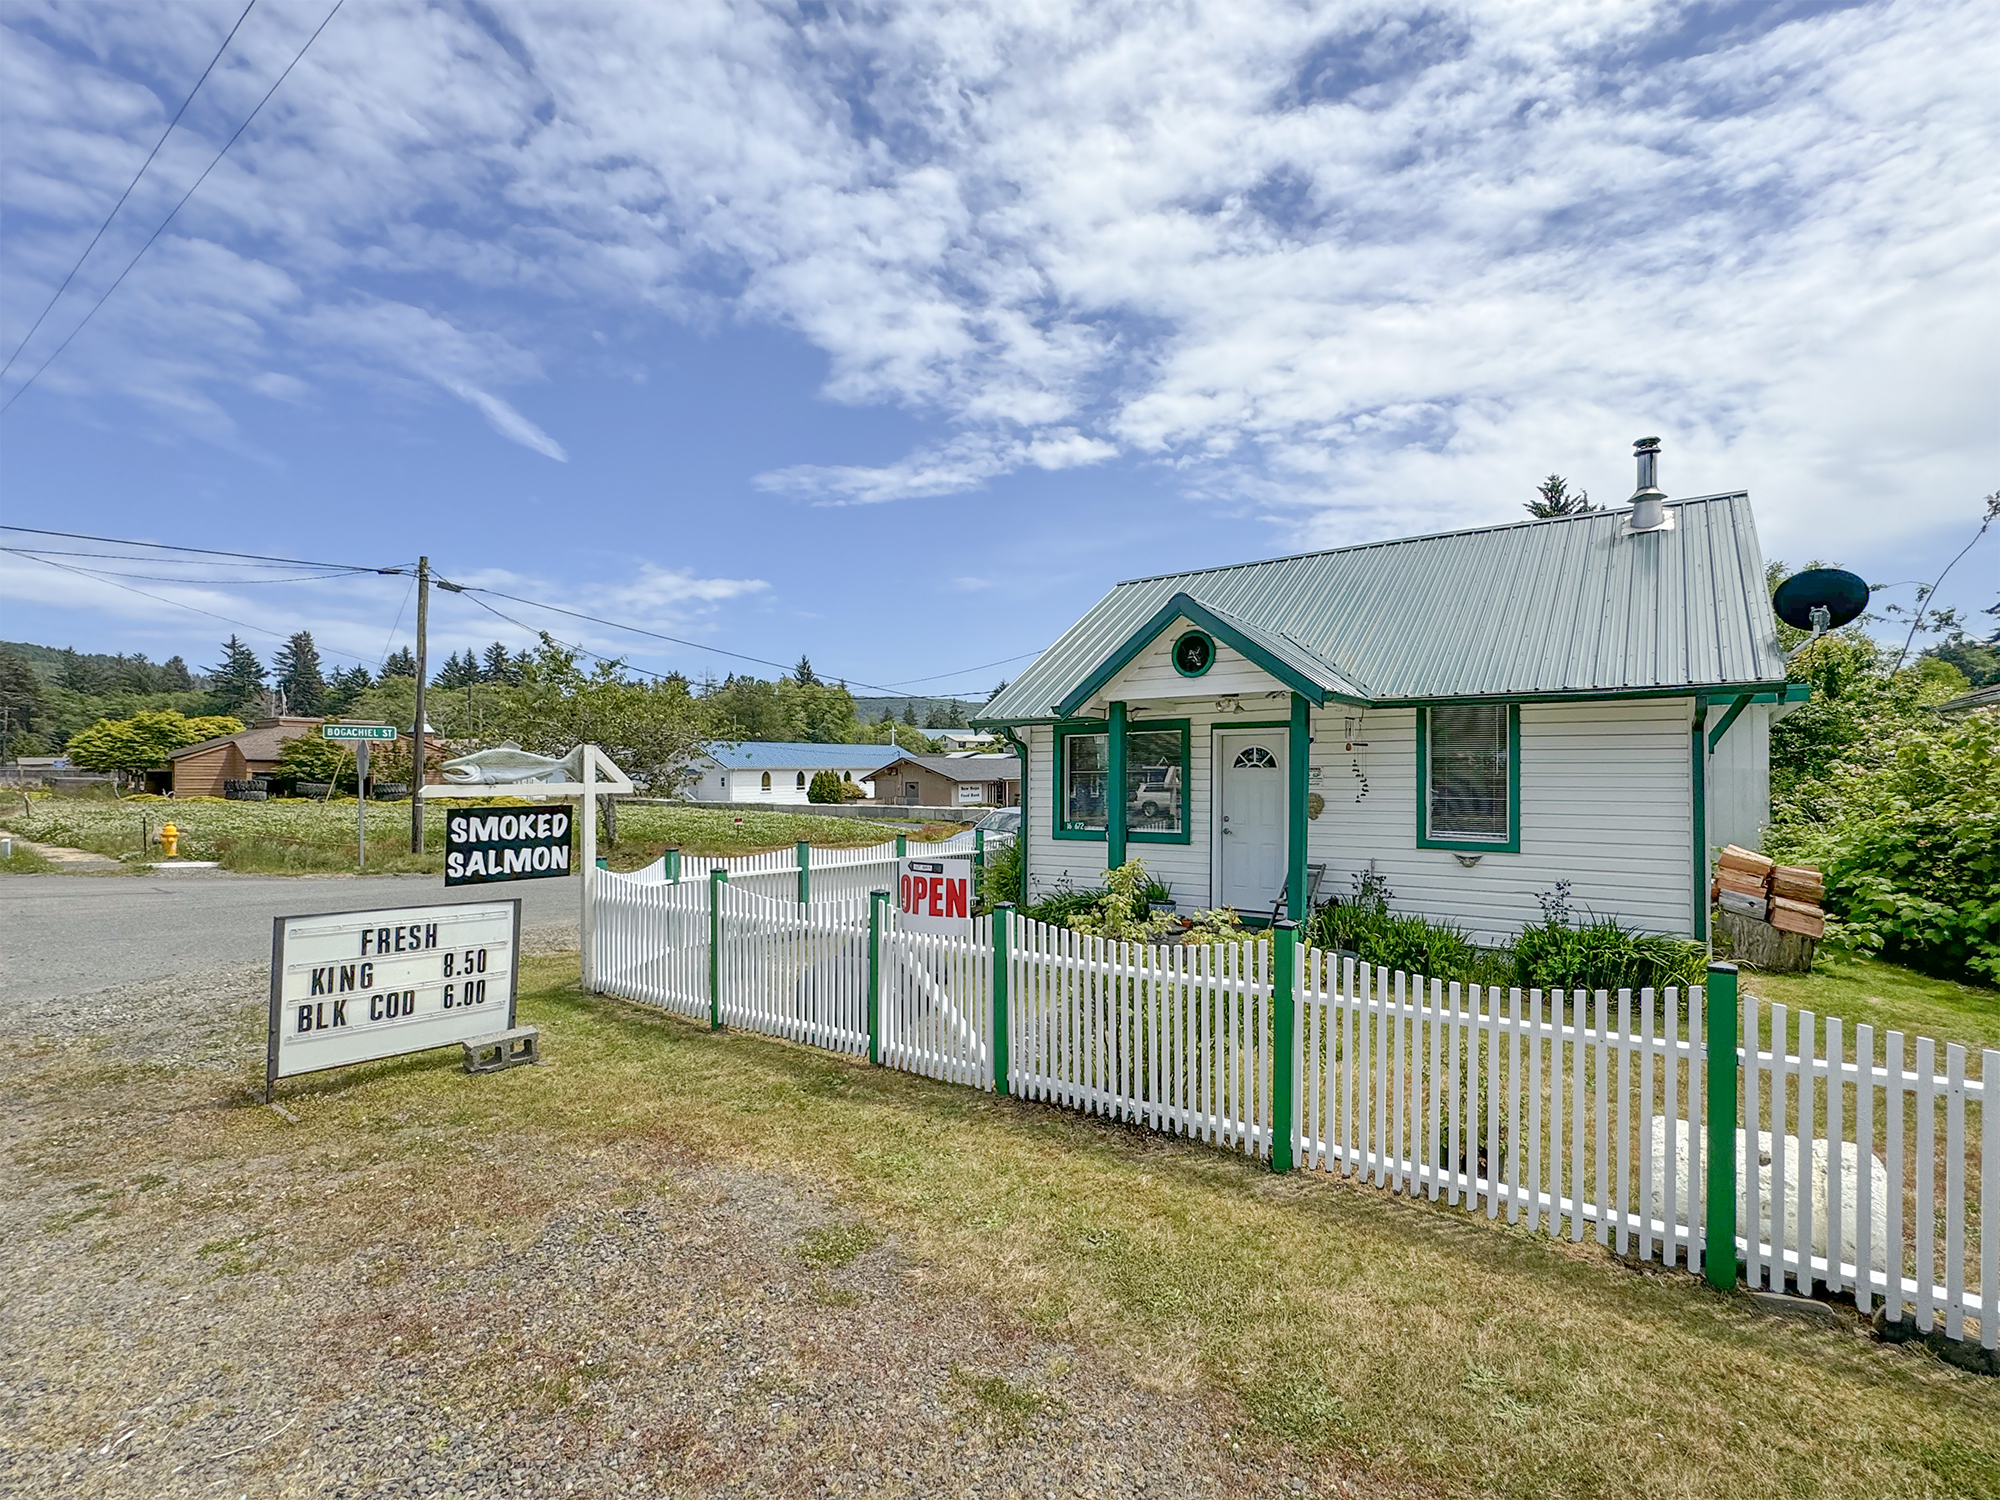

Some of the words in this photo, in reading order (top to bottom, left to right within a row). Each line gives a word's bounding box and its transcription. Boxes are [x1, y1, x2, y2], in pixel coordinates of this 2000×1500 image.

[327, 728, 379, 737] BOGACHIEL
[382, 729, 393, 738] ST
[450, 813, 569, 843] SMOKED
[447, 845, 569, 878] SALMON
[900, 874, 967, 918] OPEN
[361, 923, 438, 956] FRESH
[311, 962, 374, 996] KING
[443, 949, 487, 978] 8.50
[297, 999, 348, 1033] BLK
[370, 989, 415, 1021] COD
[443, 979, 486, 1009] 6.00
